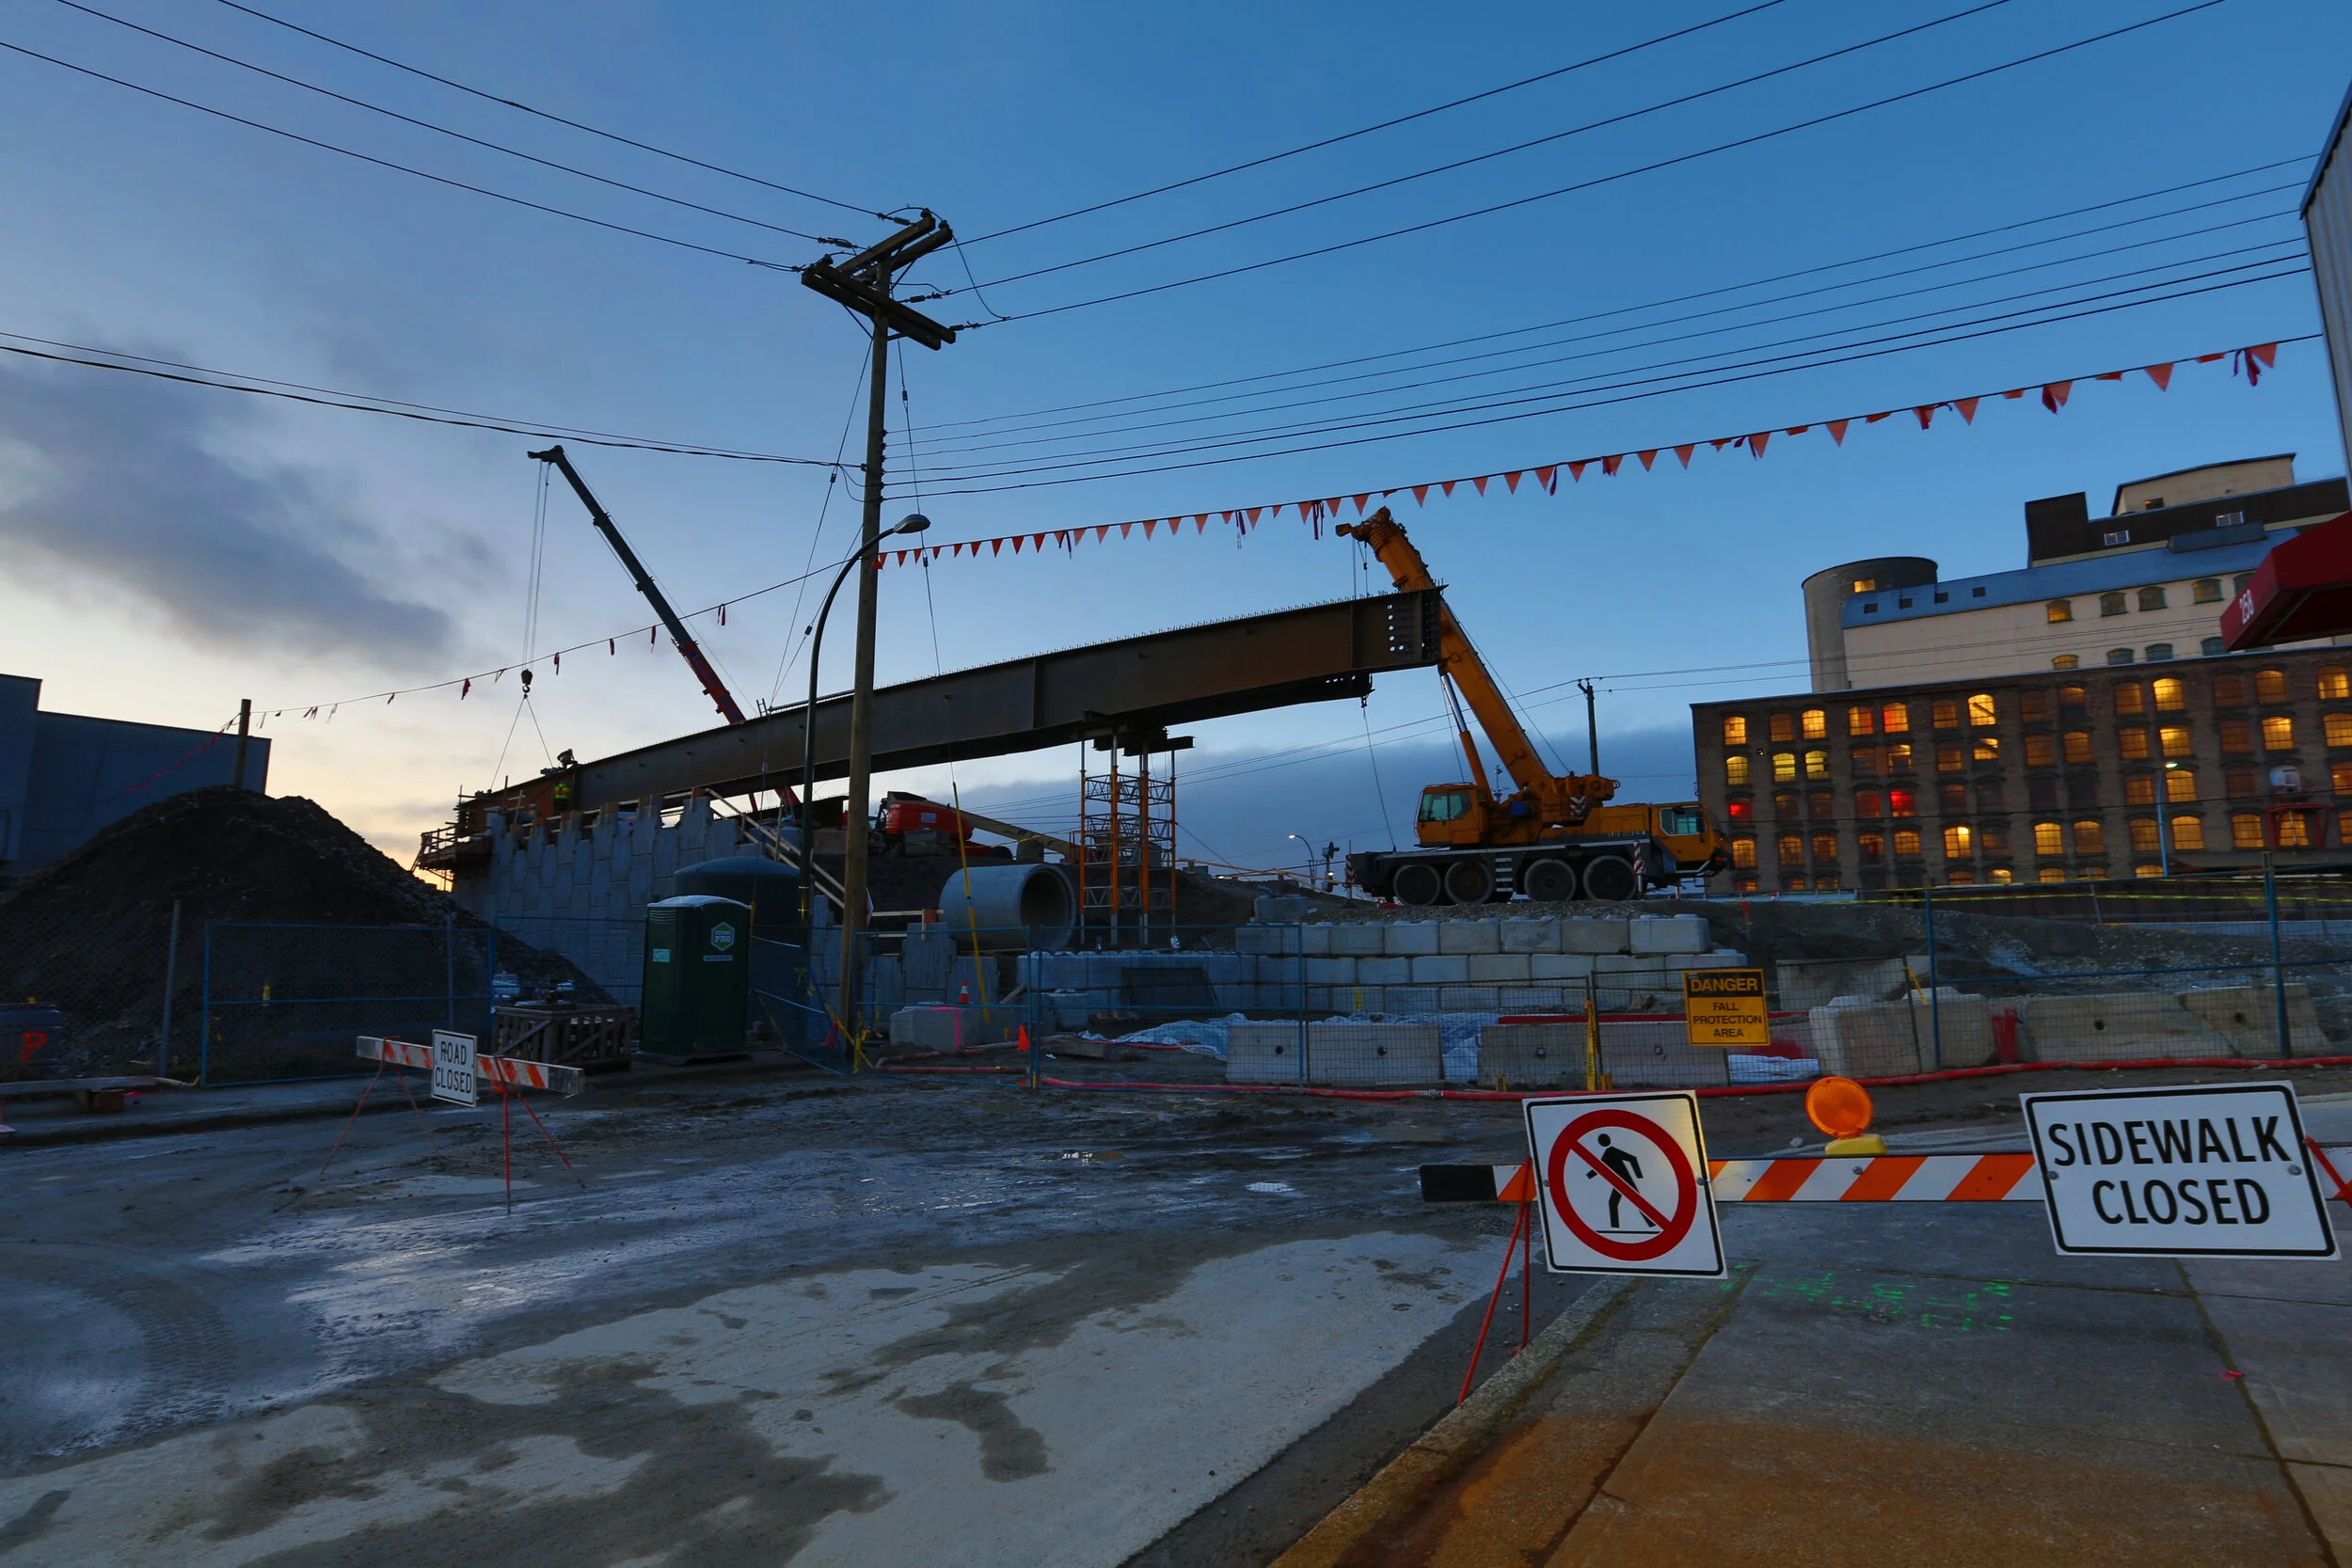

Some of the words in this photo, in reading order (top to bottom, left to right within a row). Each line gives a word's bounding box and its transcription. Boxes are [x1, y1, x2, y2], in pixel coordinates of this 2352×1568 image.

[1691, 978, 1758, 992] DANGER
[1713, 1002, 1739, 1011] FALL
[1693, 1015, 1762, 1024] PROTECTION
[1713, 1028, 1744, 1037] AREA
[21, 1031, 47, 1063] P
[441, 1041, 467, 1065] ROAD
[436, 1067, 471, 1093] CLOSED
[2048, 1116, 2292, 1166] SIDEWALK
[2092, 1178, 2270, 1225] CLOSED
